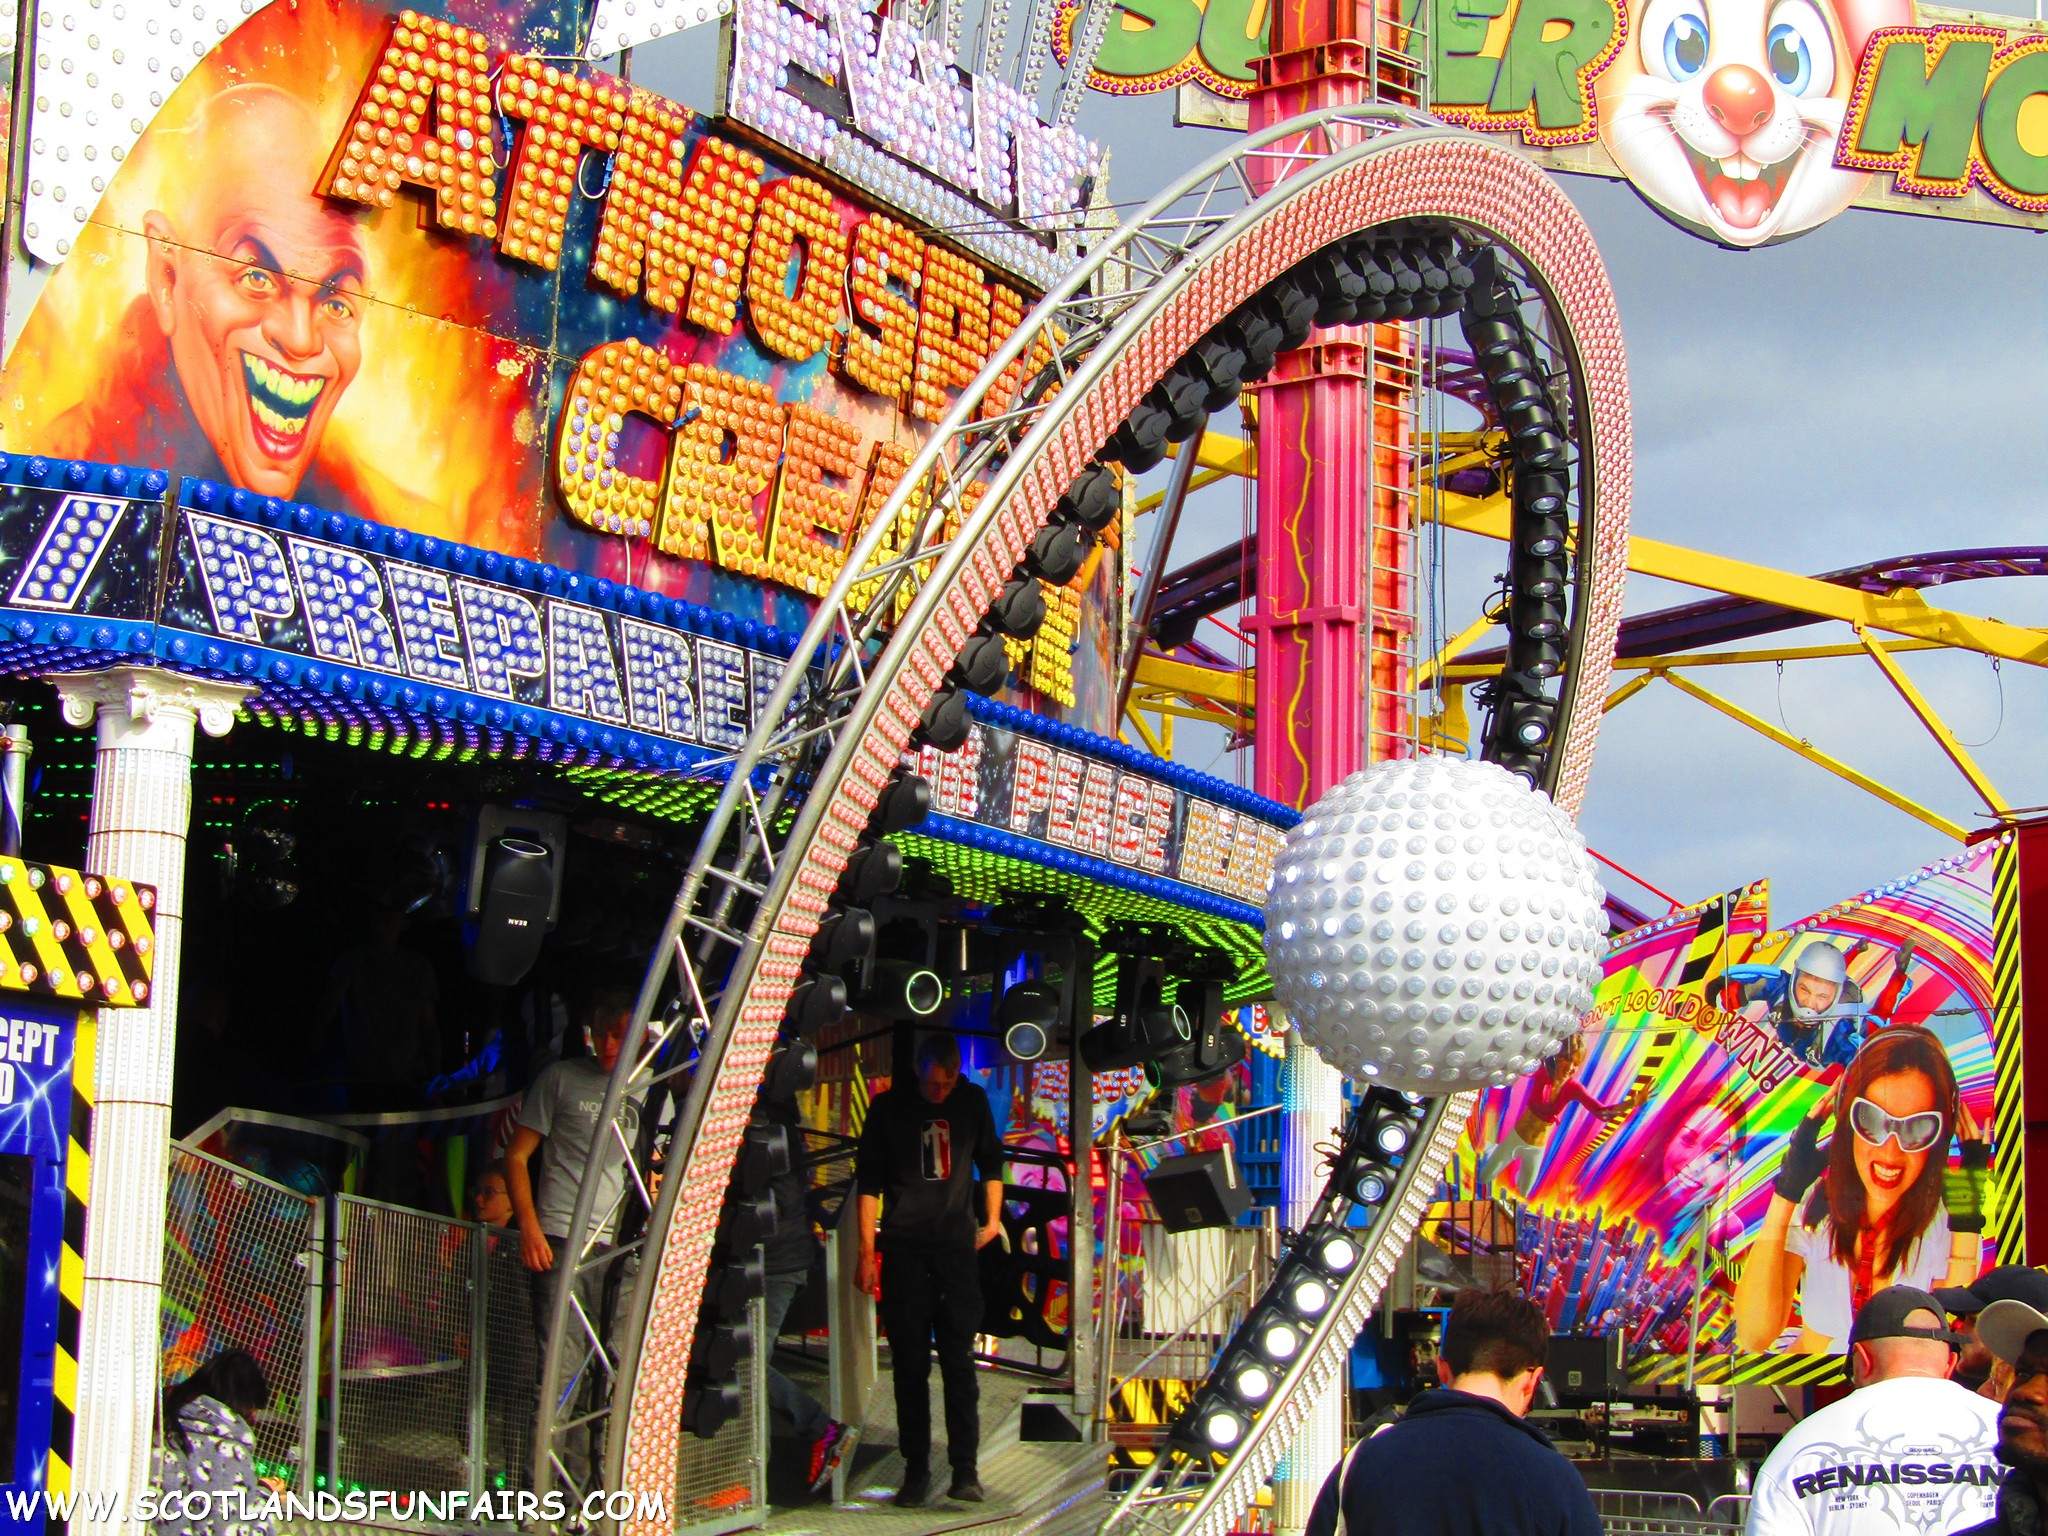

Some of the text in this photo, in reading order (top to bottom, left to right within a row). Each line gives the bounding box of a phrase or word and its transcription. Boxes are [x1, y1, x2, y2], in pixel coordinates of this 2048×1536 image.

[1090, 0, 1615, 128] SUER
[1009, 738, 1176, 874] PEACE
[1578, 988, 1803, 1095] ON'T LOOK DOWN!
[1792, 1463, 2006, 1500] RENAISSAN
[1828, 1501, 1868, 1512] BERLIN SYDNEY
